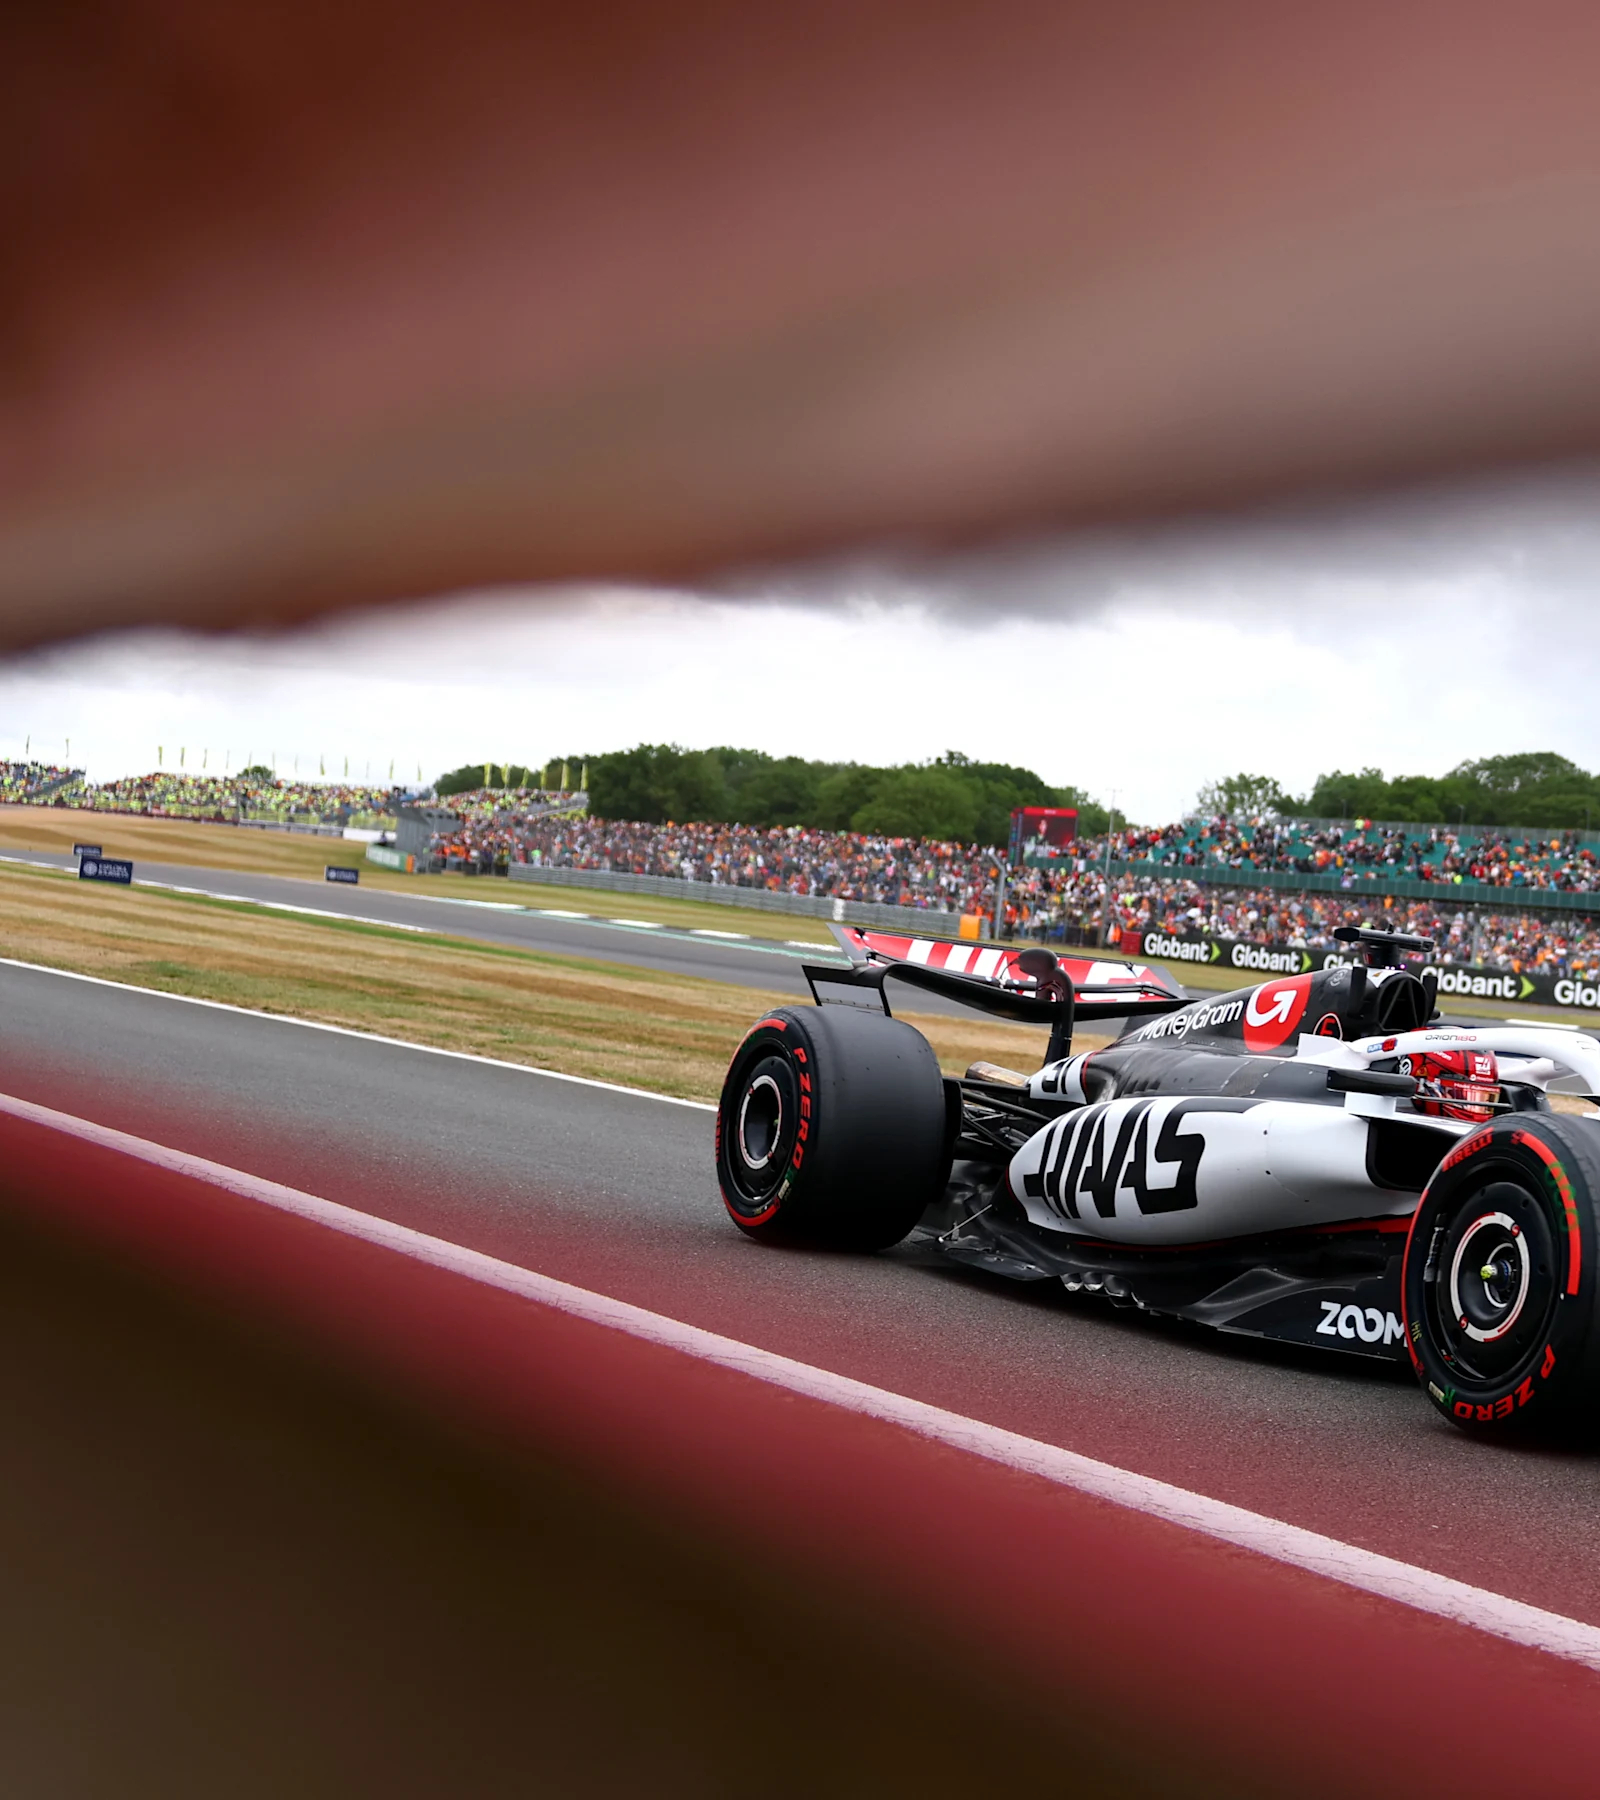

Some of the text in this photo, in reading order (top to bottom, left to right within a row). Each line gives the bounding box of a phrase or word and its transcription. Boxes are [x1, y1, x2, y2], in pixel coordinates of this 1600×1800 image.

[1144, 932, 1209, 963] Globant
[1231, 943, 1300, 973] Globant
[1137, 999, 1245, 1042] MoneyGram
[793, 1048, 811, 1169] P ZERO
[1023, 1098, 1266, 1219] HAAS
[1442, 1126, 1494, 1172] PIRELLI
[1454, 1344, 1556, 1421] P ZERO
